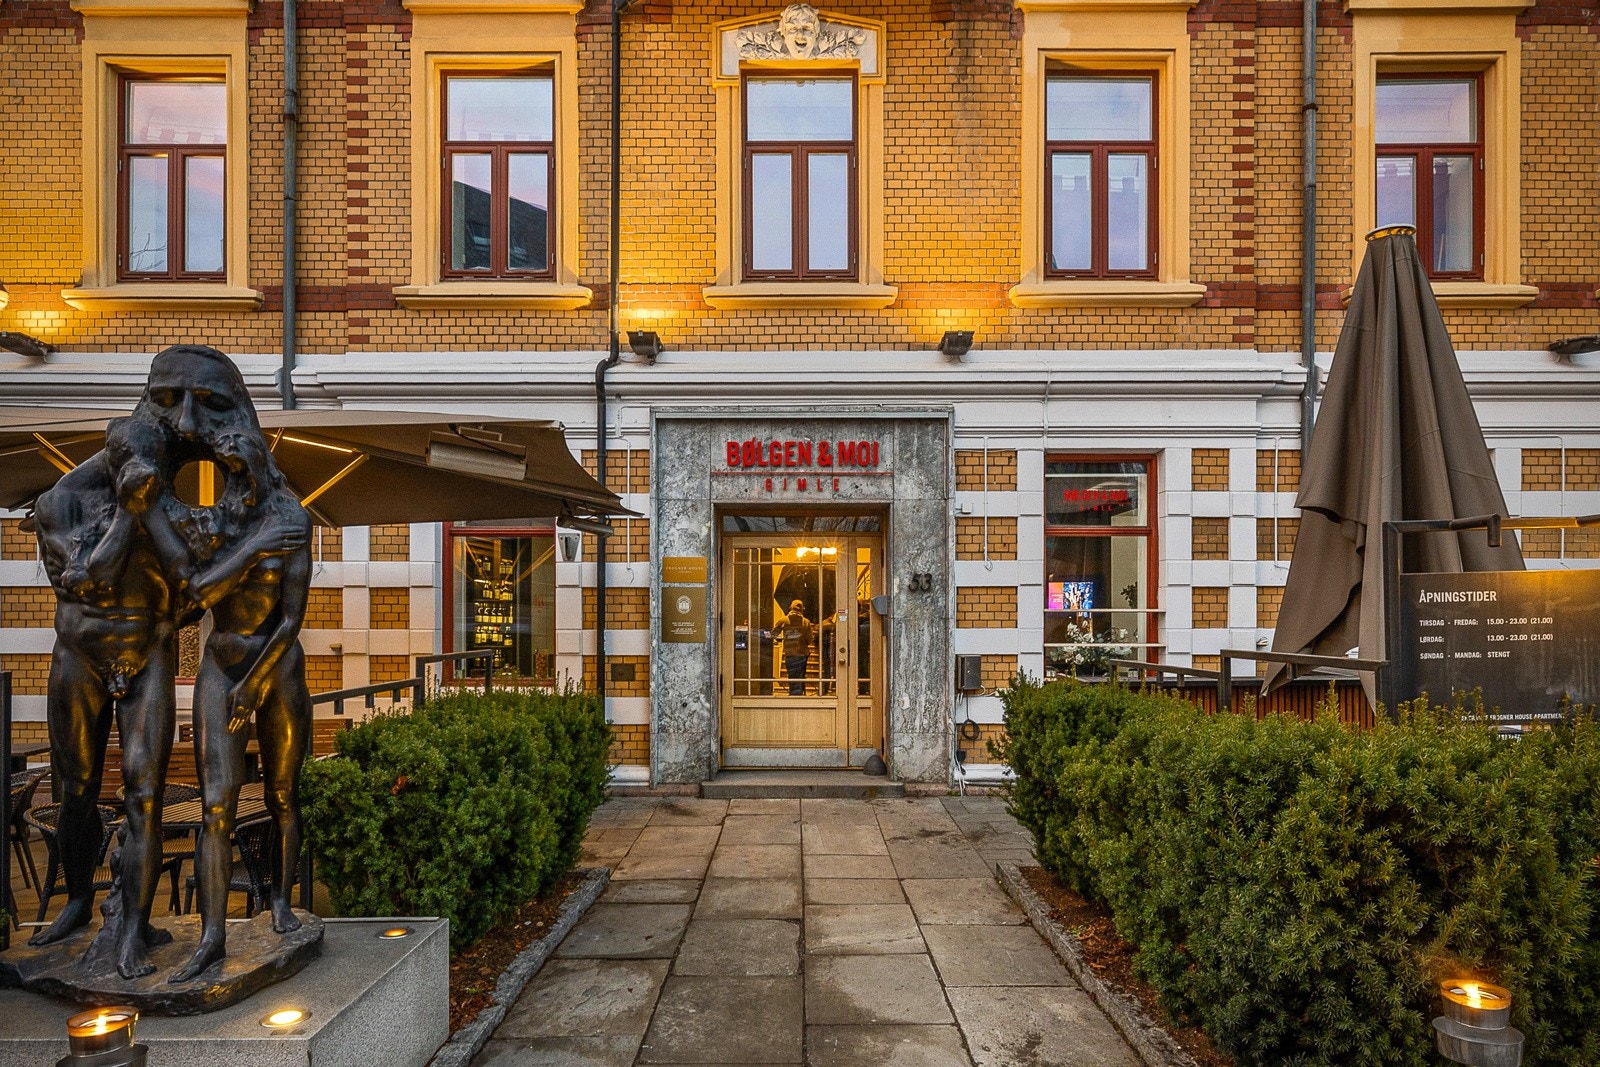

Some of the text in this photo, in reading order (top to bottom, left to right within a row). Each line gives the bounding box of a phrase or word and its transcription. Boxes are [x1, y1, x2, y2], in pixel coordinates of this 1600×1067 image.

[726, 437, 879, 469] BØLGEN & MOI
[765, 477, 840, 492] GIMLE
[908, 572, 932, 593] 53
[1418, 590, 1497, 603] ÅPNINGSTIDER
